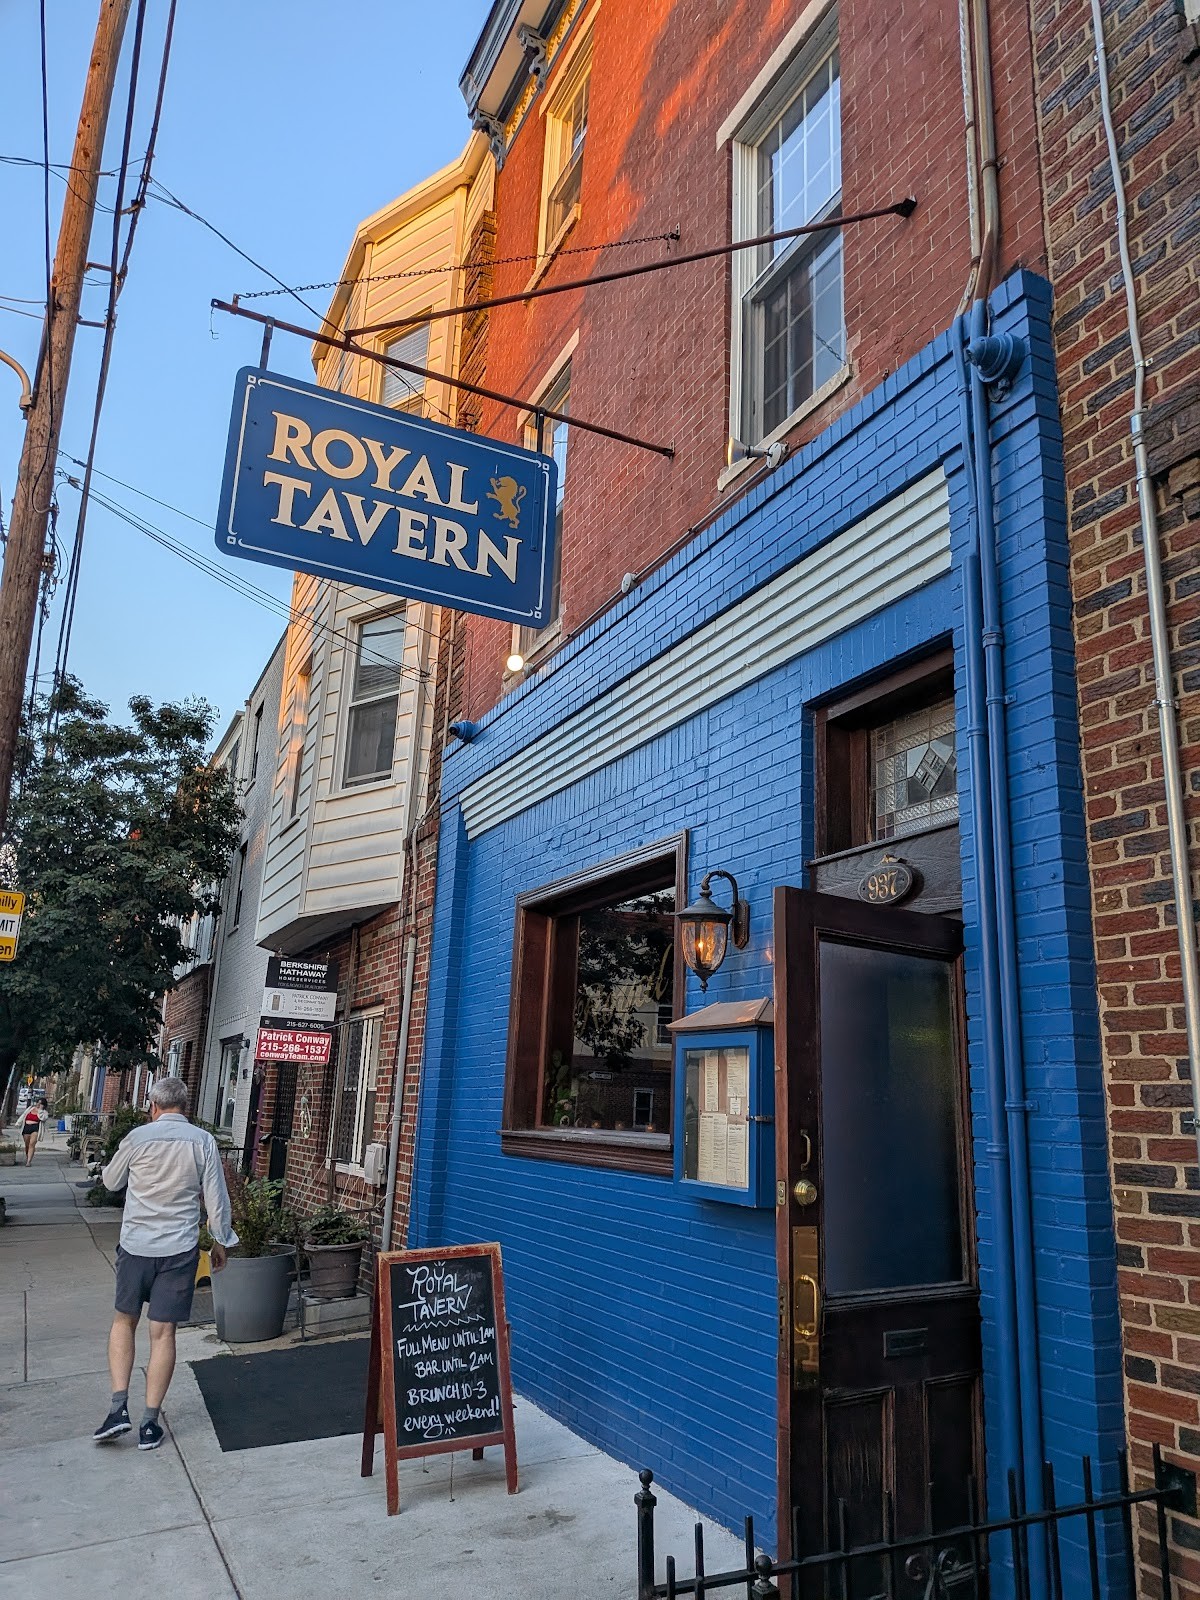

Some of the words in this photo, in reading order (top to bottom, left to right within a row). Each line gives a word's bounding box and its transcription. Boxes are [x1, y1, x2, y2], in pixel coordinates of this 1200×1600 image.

[266, 410, 479, 516] ROYAL
[263, 470, 523, 584] TAVERN
[868, 870, 898, 899] 937
[279, 968, 327, 978] HATHAWAY
[280, 960, 329, 971] BERKSHIRE
[278, 976, 326, 984] HOMESERVICES
[260, 1031, 294, 1041] Patrick
[295, 1033, 330, 1046] Conway
[286, 1021, 325, 1030] 215-627-6005
[260, 1042, 327, 1055] 215-266-1537
[260, 1051, 326, 1062] conwayTeam.com
[406, 1264, 469, 1300] ROYAL
[398, 1286, 473, 1322] TAVERN
[397, 1338, 422, 1359] FULL
[421, 1336, 450, 1355] MENU
[452, 1331, 479, 1349] UNTIL
[478, 1327, 496, 1346] 1AM
[414, 1361, 441, 1378] BAR
[441, 1358, 468, 1373] UNTIL
[469, 1351, 495, 1372] 2AM
[407, 1381, 461, 1407] BRUNCH
[461, 1381, 488, 1400] 10-3
[403, 1413, 445, 1439] every
[444, 1395, 500, 1427] weekend!
